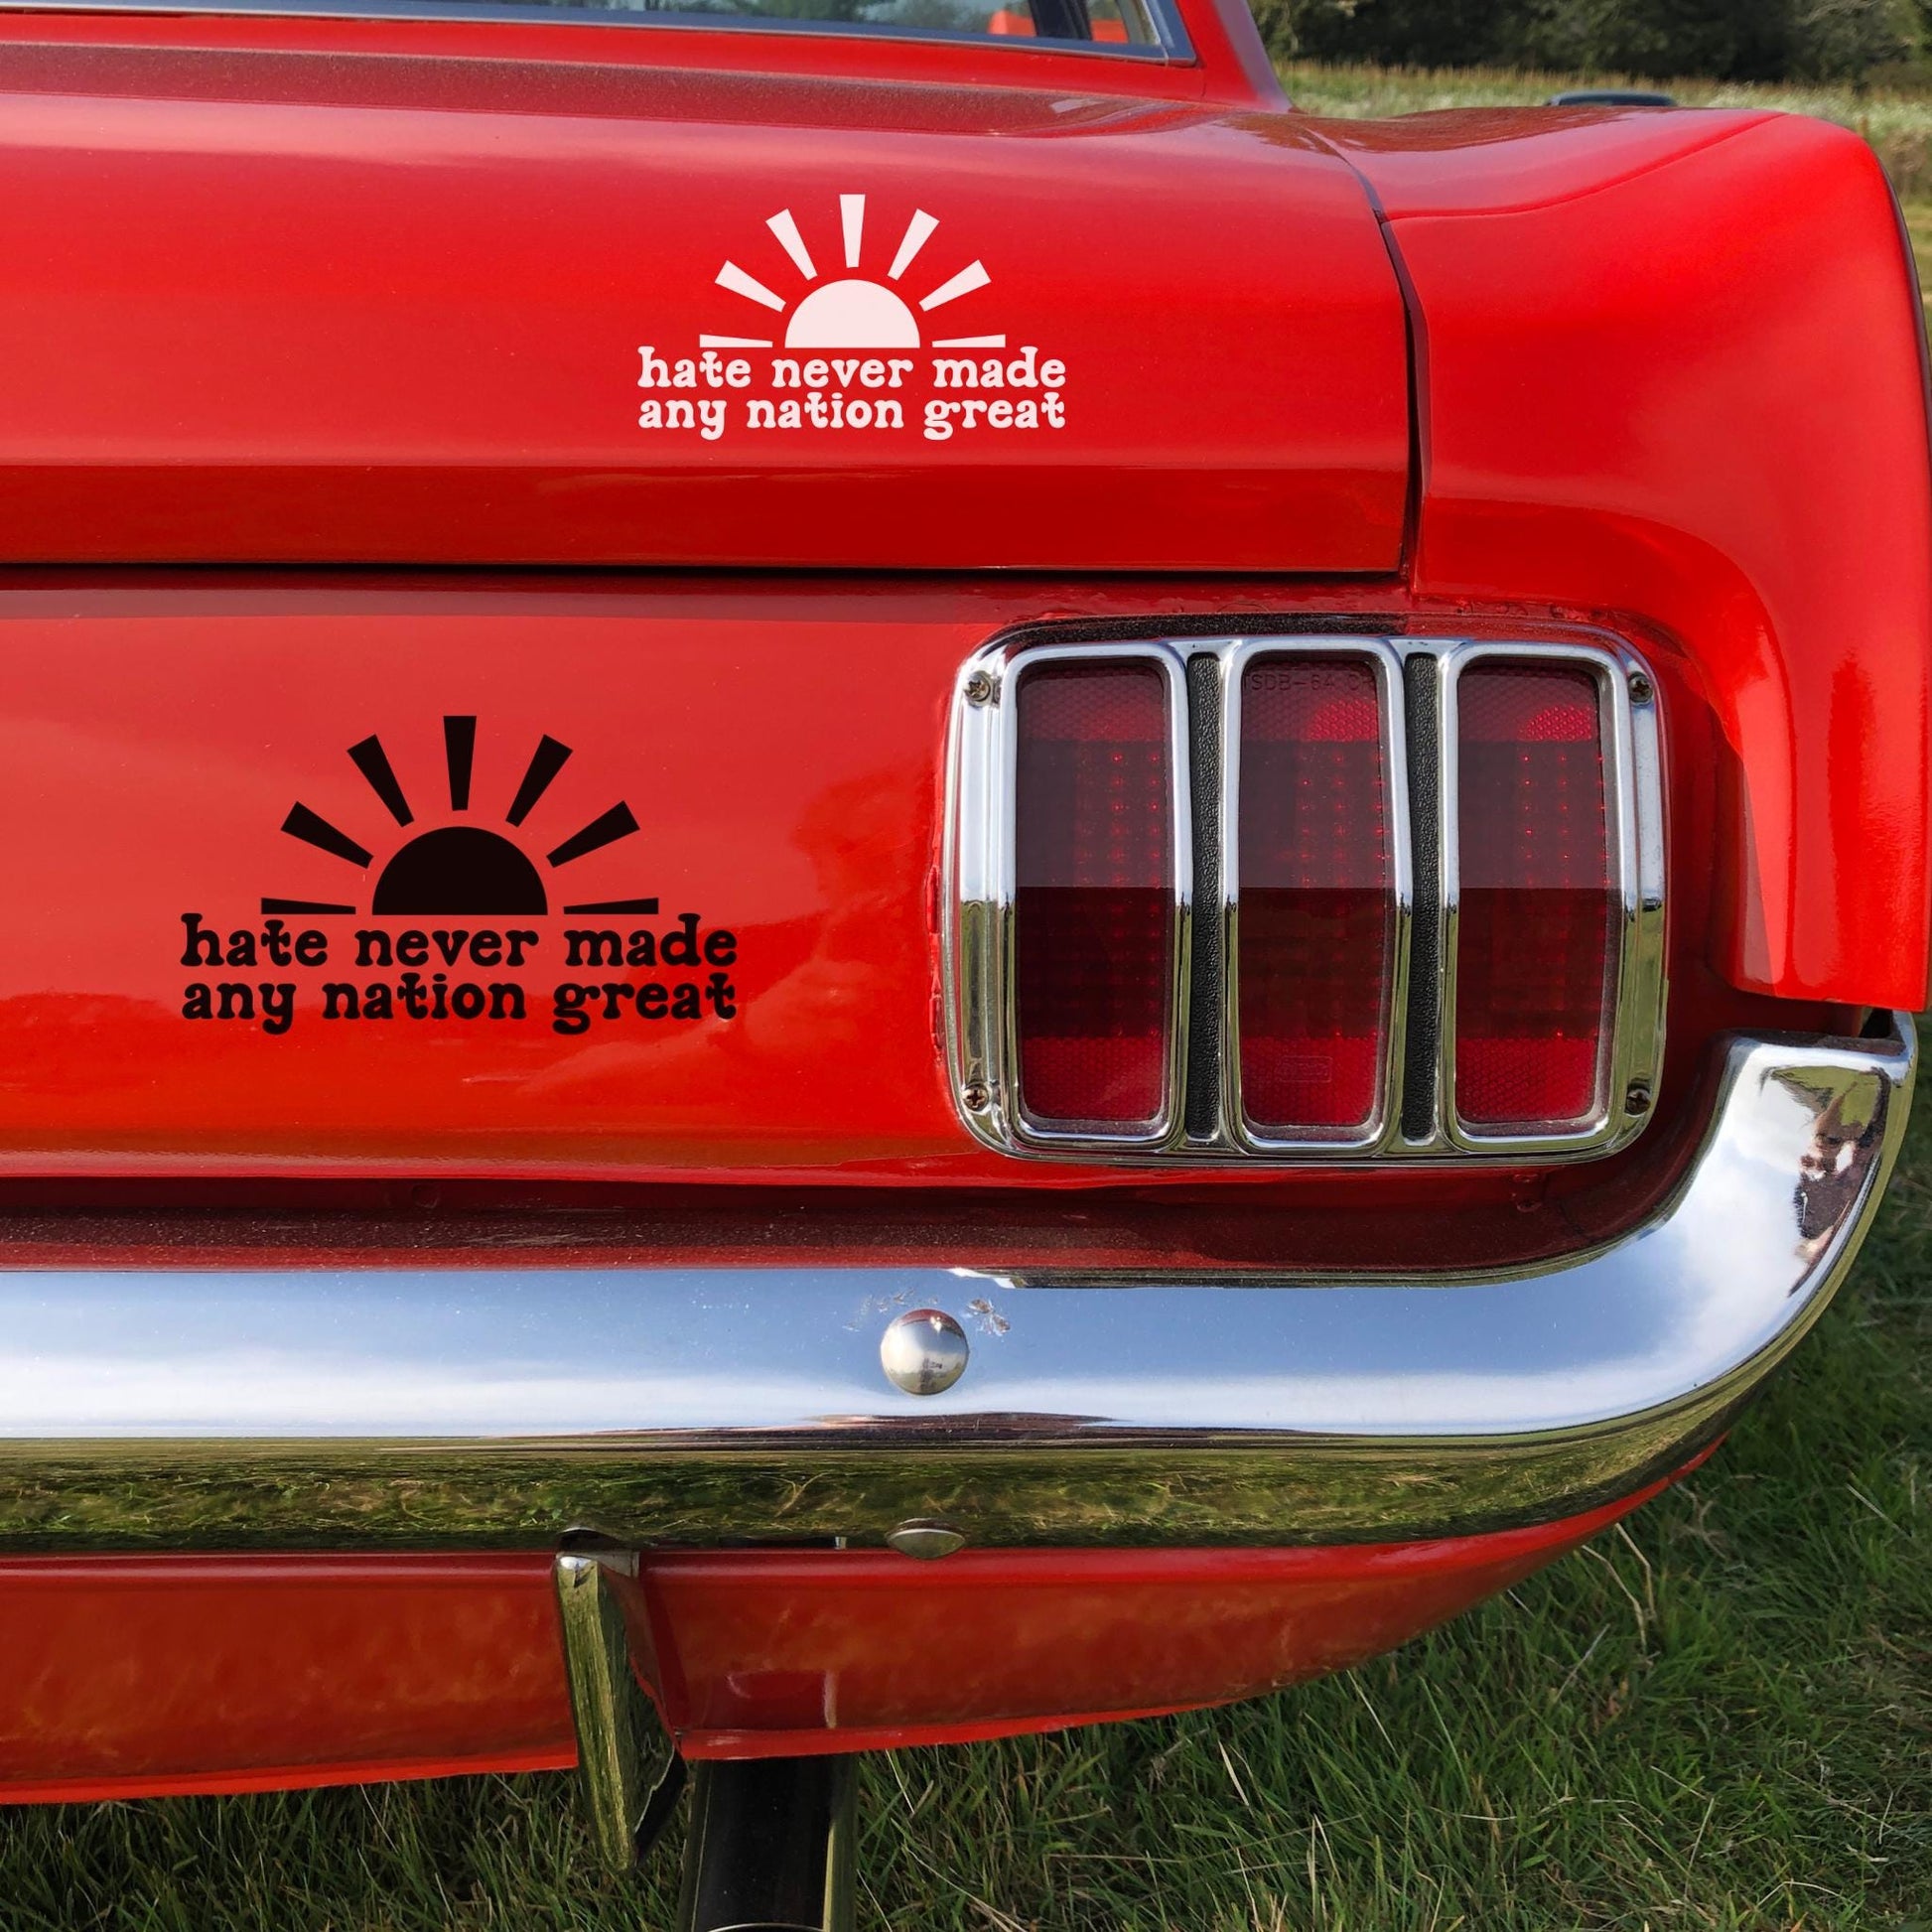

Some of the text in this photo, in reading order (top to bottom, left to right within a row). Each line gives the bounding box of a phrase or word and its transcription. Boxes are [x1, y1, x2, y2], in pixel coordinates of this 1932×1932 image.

[638, 346, 1065, 387] hate never made
[639, 392, 1064, 440] any nation great
[181, 913, 737, 966] hate never made
[183, 973, 736, 1035] any nation great
